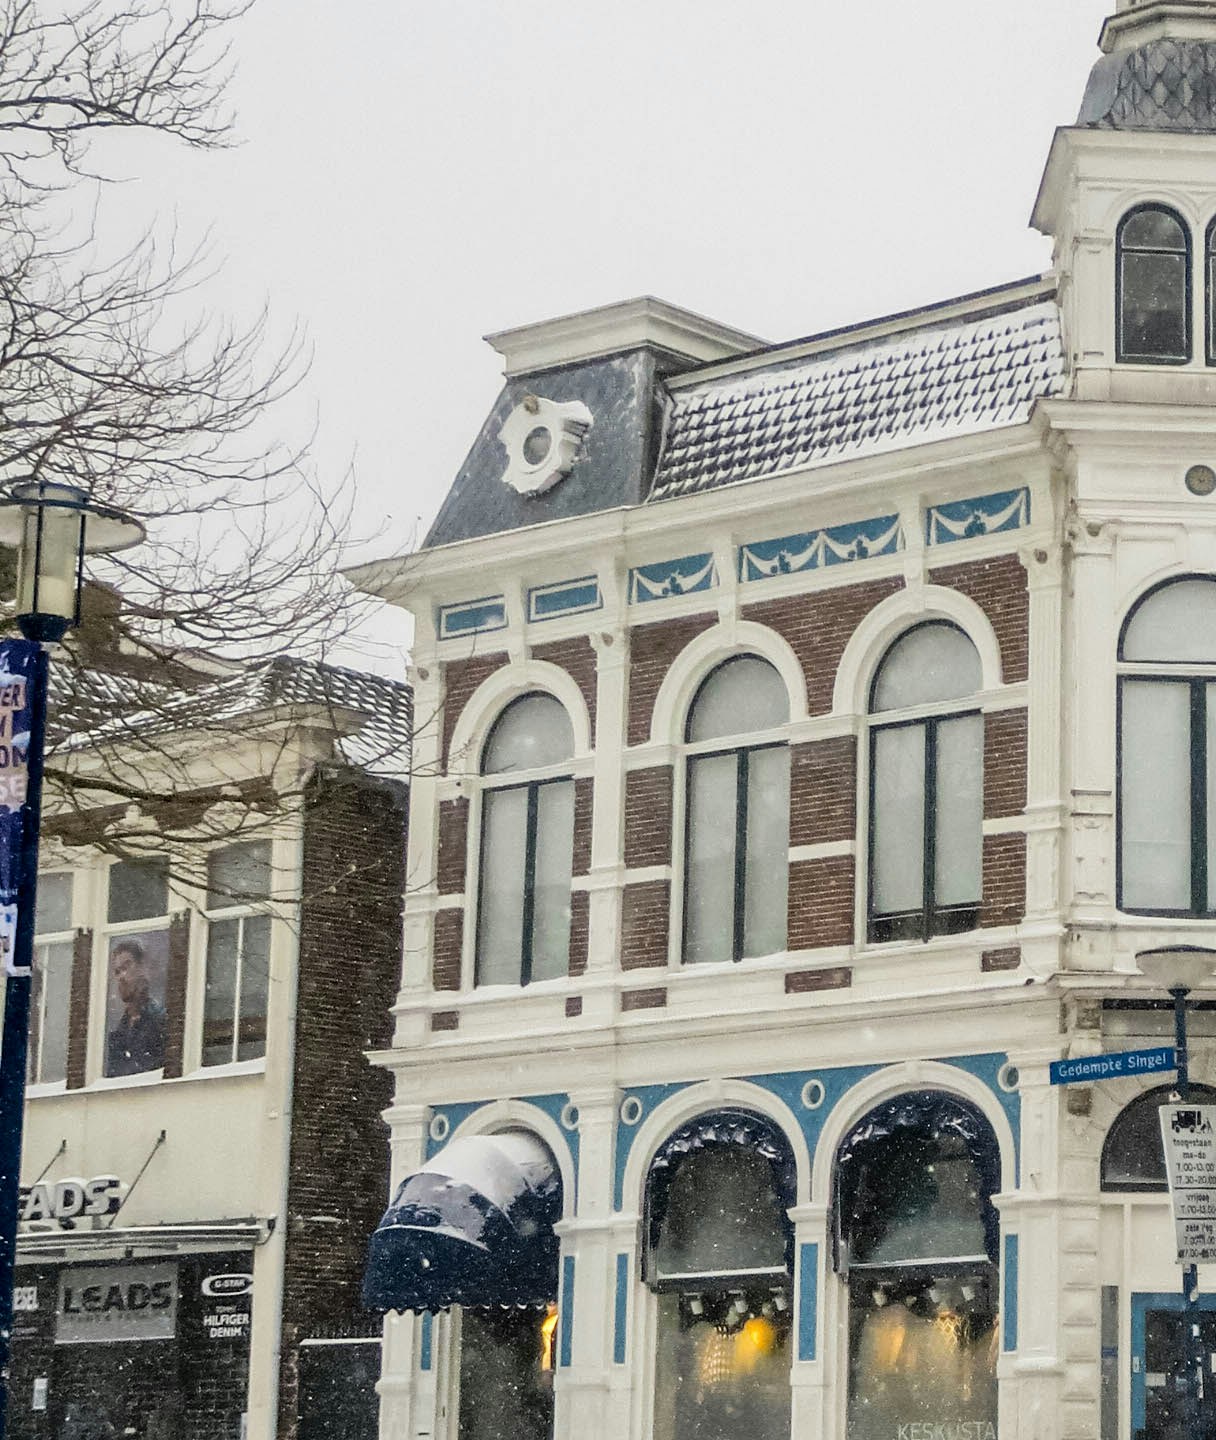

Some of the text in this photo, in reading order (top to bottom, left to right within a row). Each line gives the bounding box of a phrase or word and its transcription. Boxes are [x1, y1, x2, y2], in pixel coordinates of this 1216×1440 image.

[1059, 1053, 1166, 1077] Gedempte Singel
[19, 1177, 122, 1220] ADS
[63, 1281, 172, 1313] LEADS
[203, 1313, 249, 1327] HILFIGER
[210, 1326, 243, 1338] DENIM
